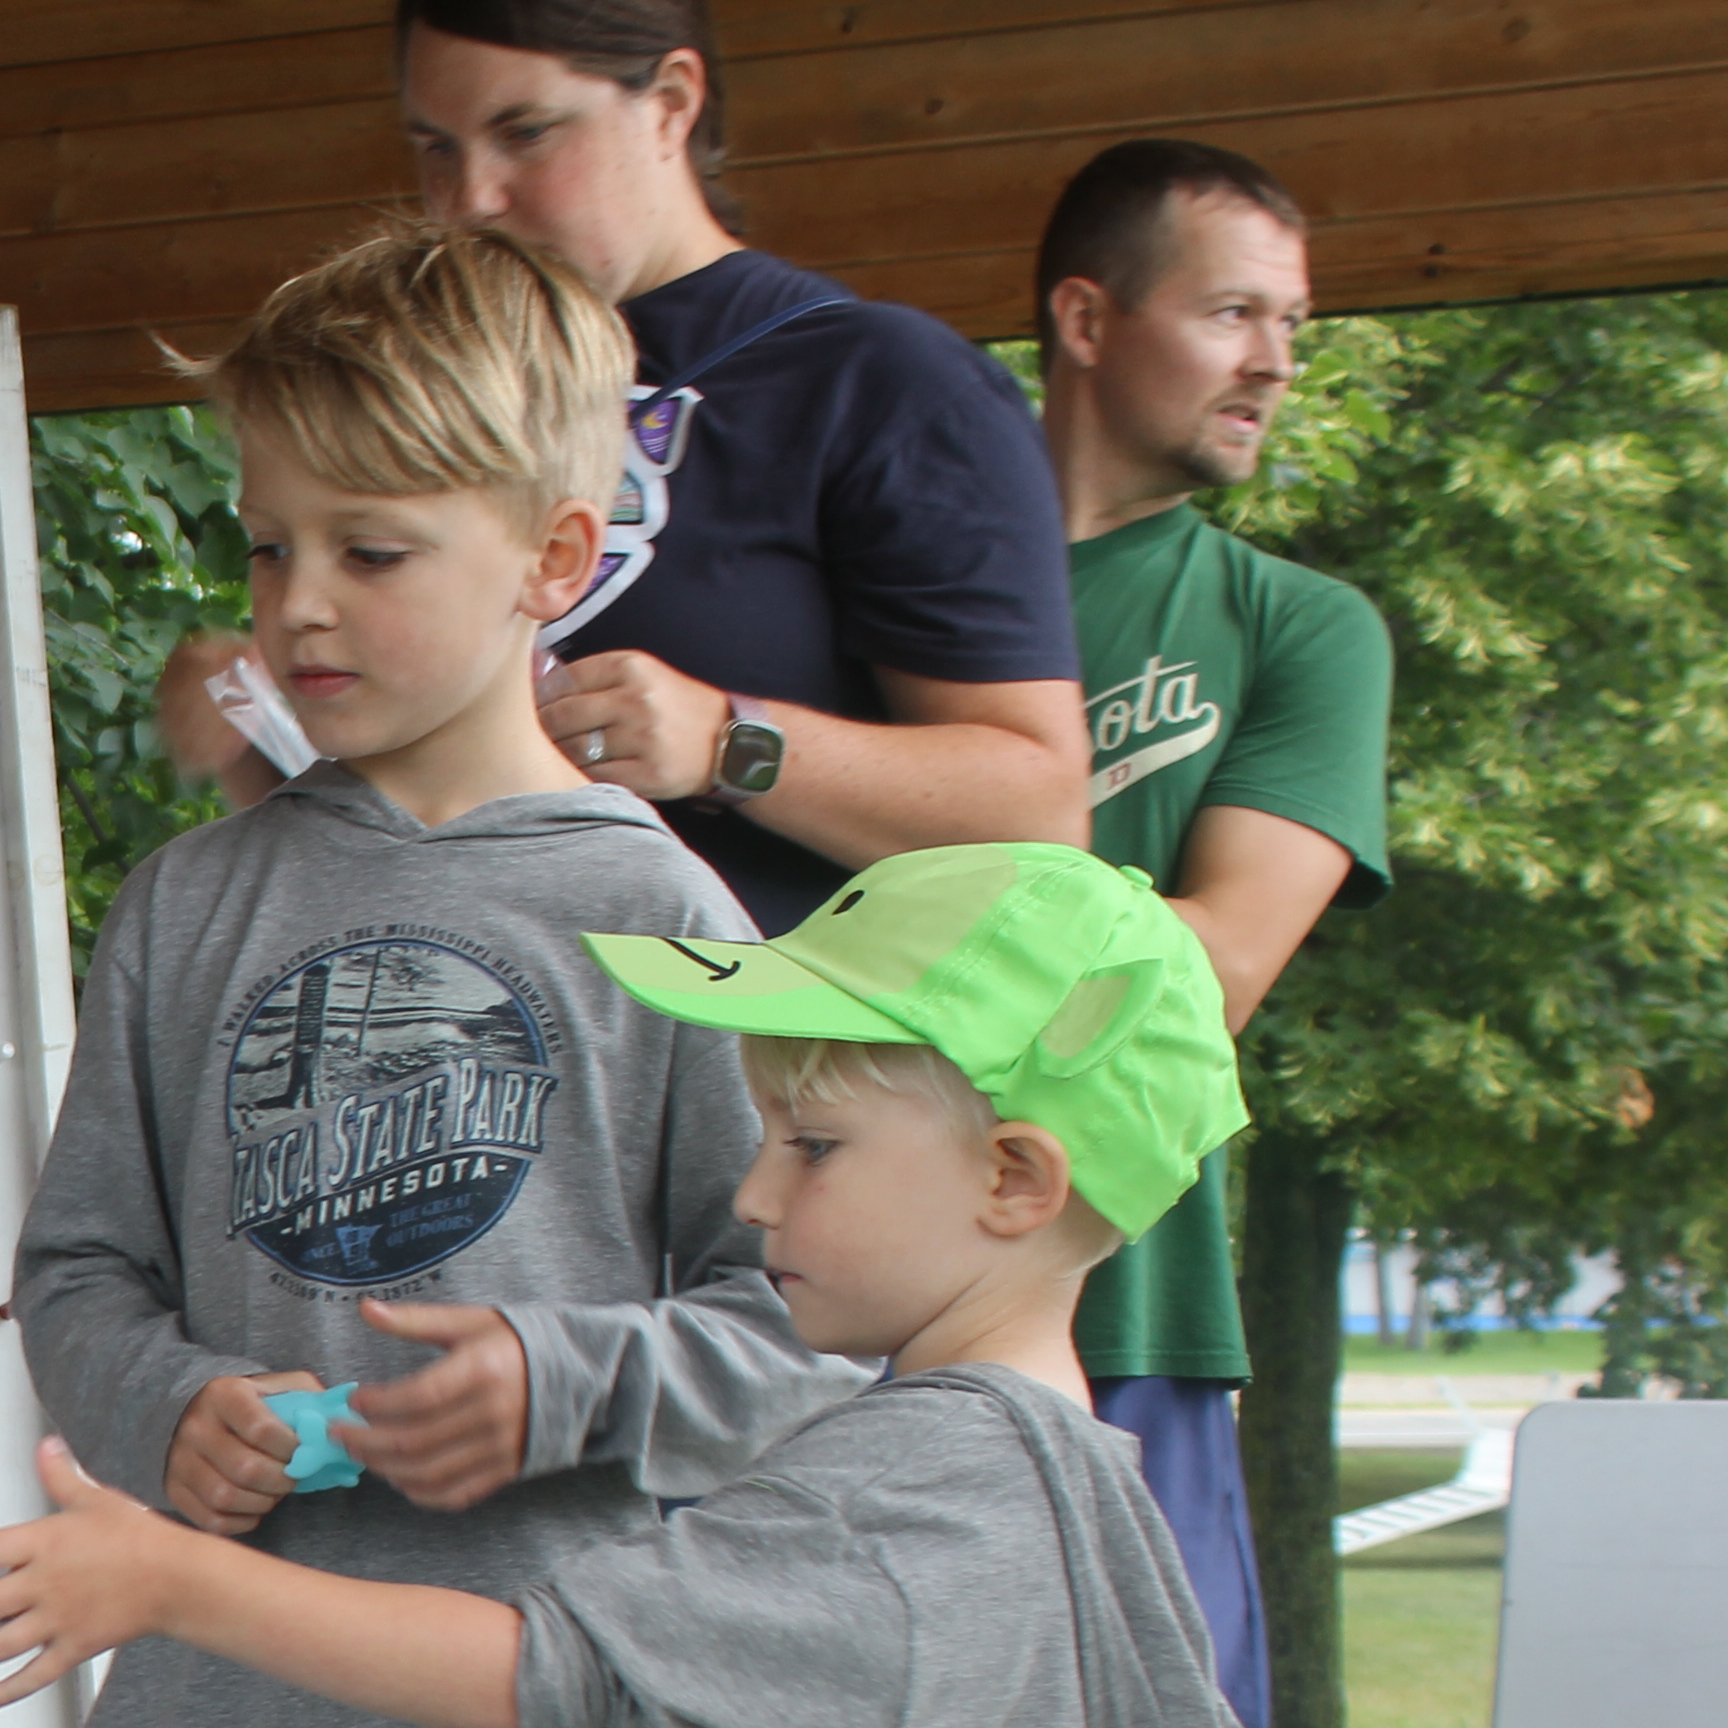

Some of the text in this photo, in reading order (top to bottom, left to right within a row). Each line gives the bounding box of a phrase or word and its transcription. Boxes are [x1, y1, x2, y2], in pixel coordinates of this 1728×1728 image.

[1084, 654, 1200, 751] ota
[222, 974, 274, 1031] WALKED
[280, 935, 337, 971] ACROSS
[345, 925, 376, 942] THE
[385, 923, 493, 961] MISSISSIPPI
[492, 957, 563, 1055] HEADWATERS
[229, 1055, 559, 1230] TASCA STATE PARK
